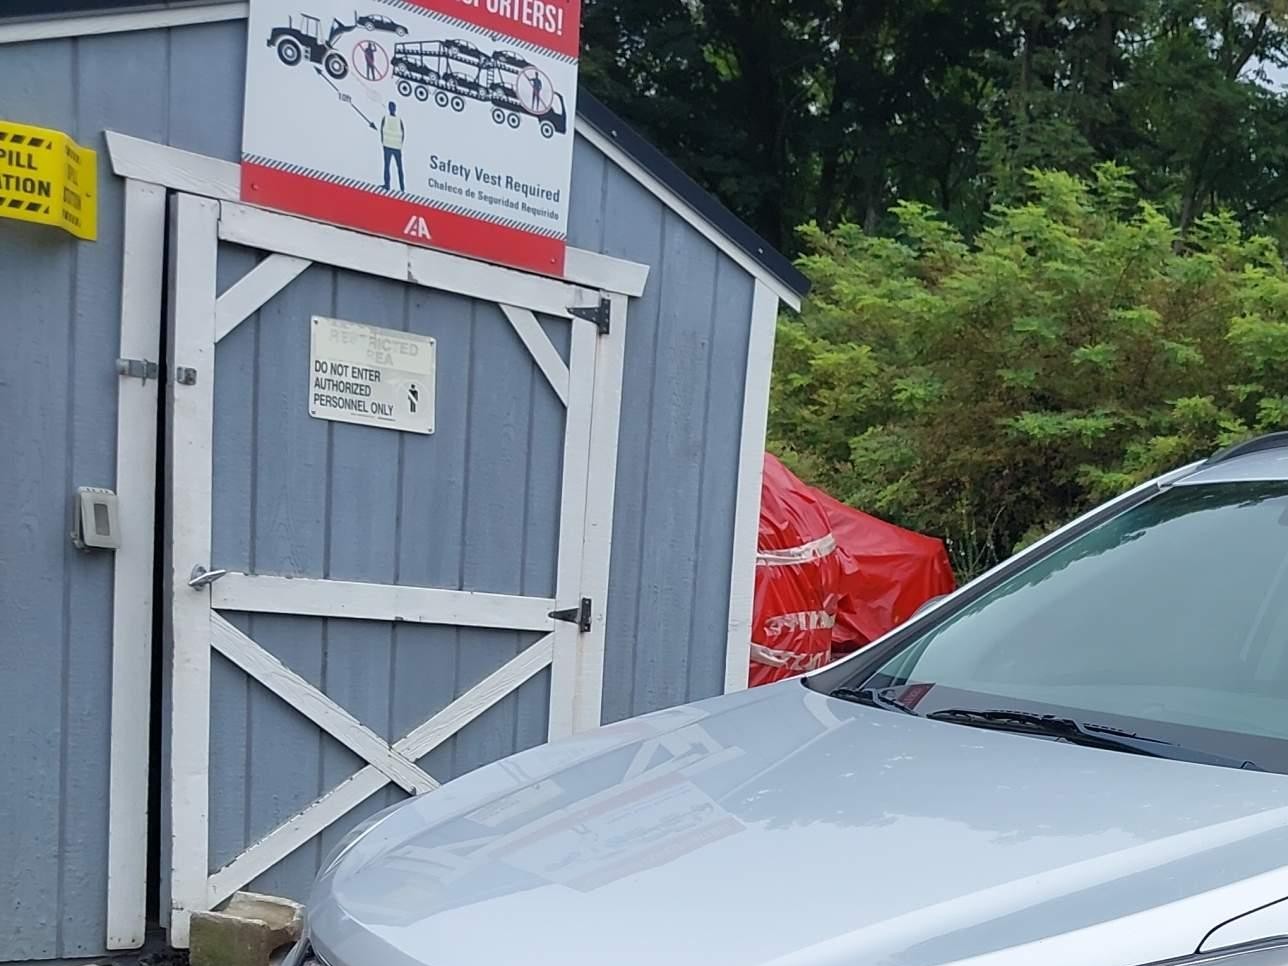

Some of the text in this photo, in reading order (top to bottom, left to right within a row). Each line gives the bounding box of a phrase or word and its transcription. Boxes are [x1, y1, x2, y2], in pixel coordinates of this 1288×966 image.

[0, 174, 51, 198] TION
[429, 154, 561, 203] Safety Vest Required
[428, 177, 463, 196] Chaleco
[465, 187, 476, 199] de
[477, 191, 520, 211] Seguridad
[314, 359, 381, 383] DO NOT ENTER
[314, 377, 371, 397] AUTHORIZED
[313, 393, 369, 413] PERSONNEL
[370, 401, 394, 417] ONLY
